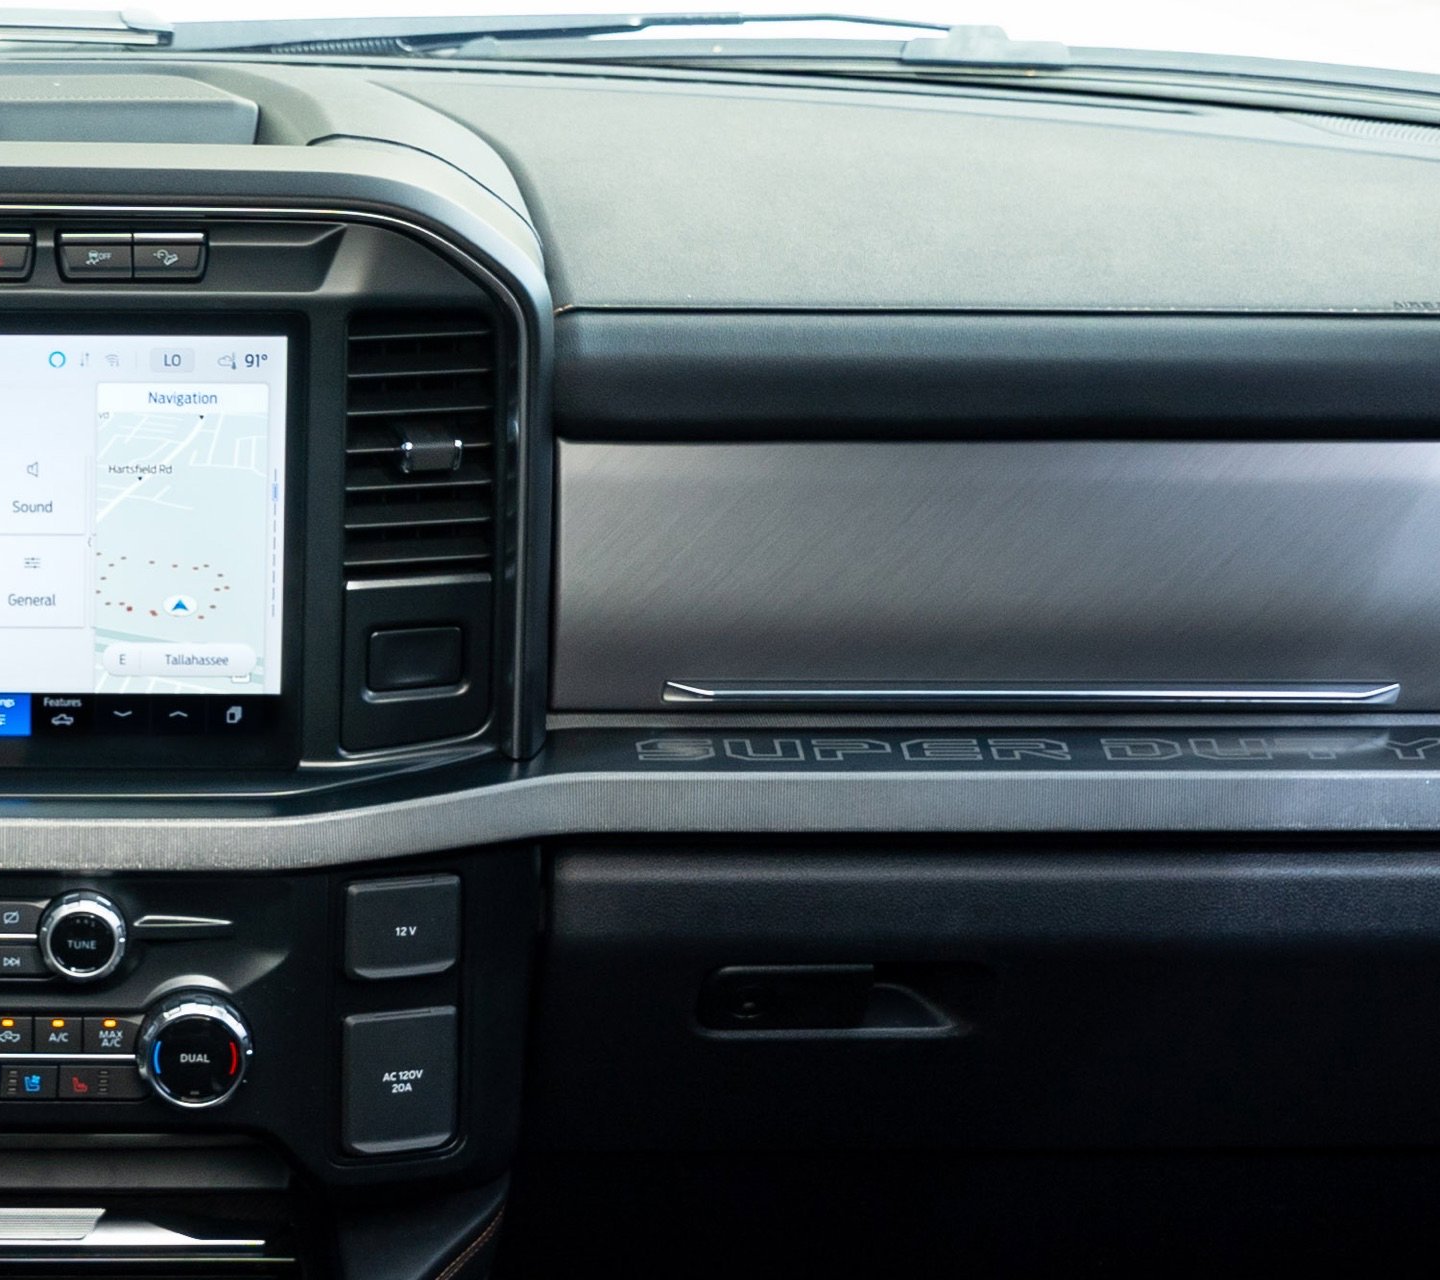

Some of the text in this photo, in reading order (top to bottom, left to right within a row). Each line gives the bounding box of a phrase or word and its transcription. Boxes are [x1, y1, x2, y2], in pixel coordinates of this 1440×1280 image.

[163, 353, 182, 368] LO
[147, 391, 218, 407] Navigation
[108, 464, 173, 474] Hartsfield Rd
[12, 500, 53, 514] Sound
[8, 593, 56, 607] General
[119, 654, 229, 666] E Tallahassee
[43, 697, 82, 708] Features
[634, 736, 1071, 762] SUPER
[395, 926, 417, 937] 12 V
[67, 940, 97, 950] TUNE
[48, 1032, 69, 1043] A/C
[98, 1030, 124, 1039] MAX
[101, 1038, 121, 1048] A/C
[179, 1053, 211, 1064] DUAL
[382, 1069, 424, 1082] AC 120V
[391, 1082, 413, 1093] 20A
